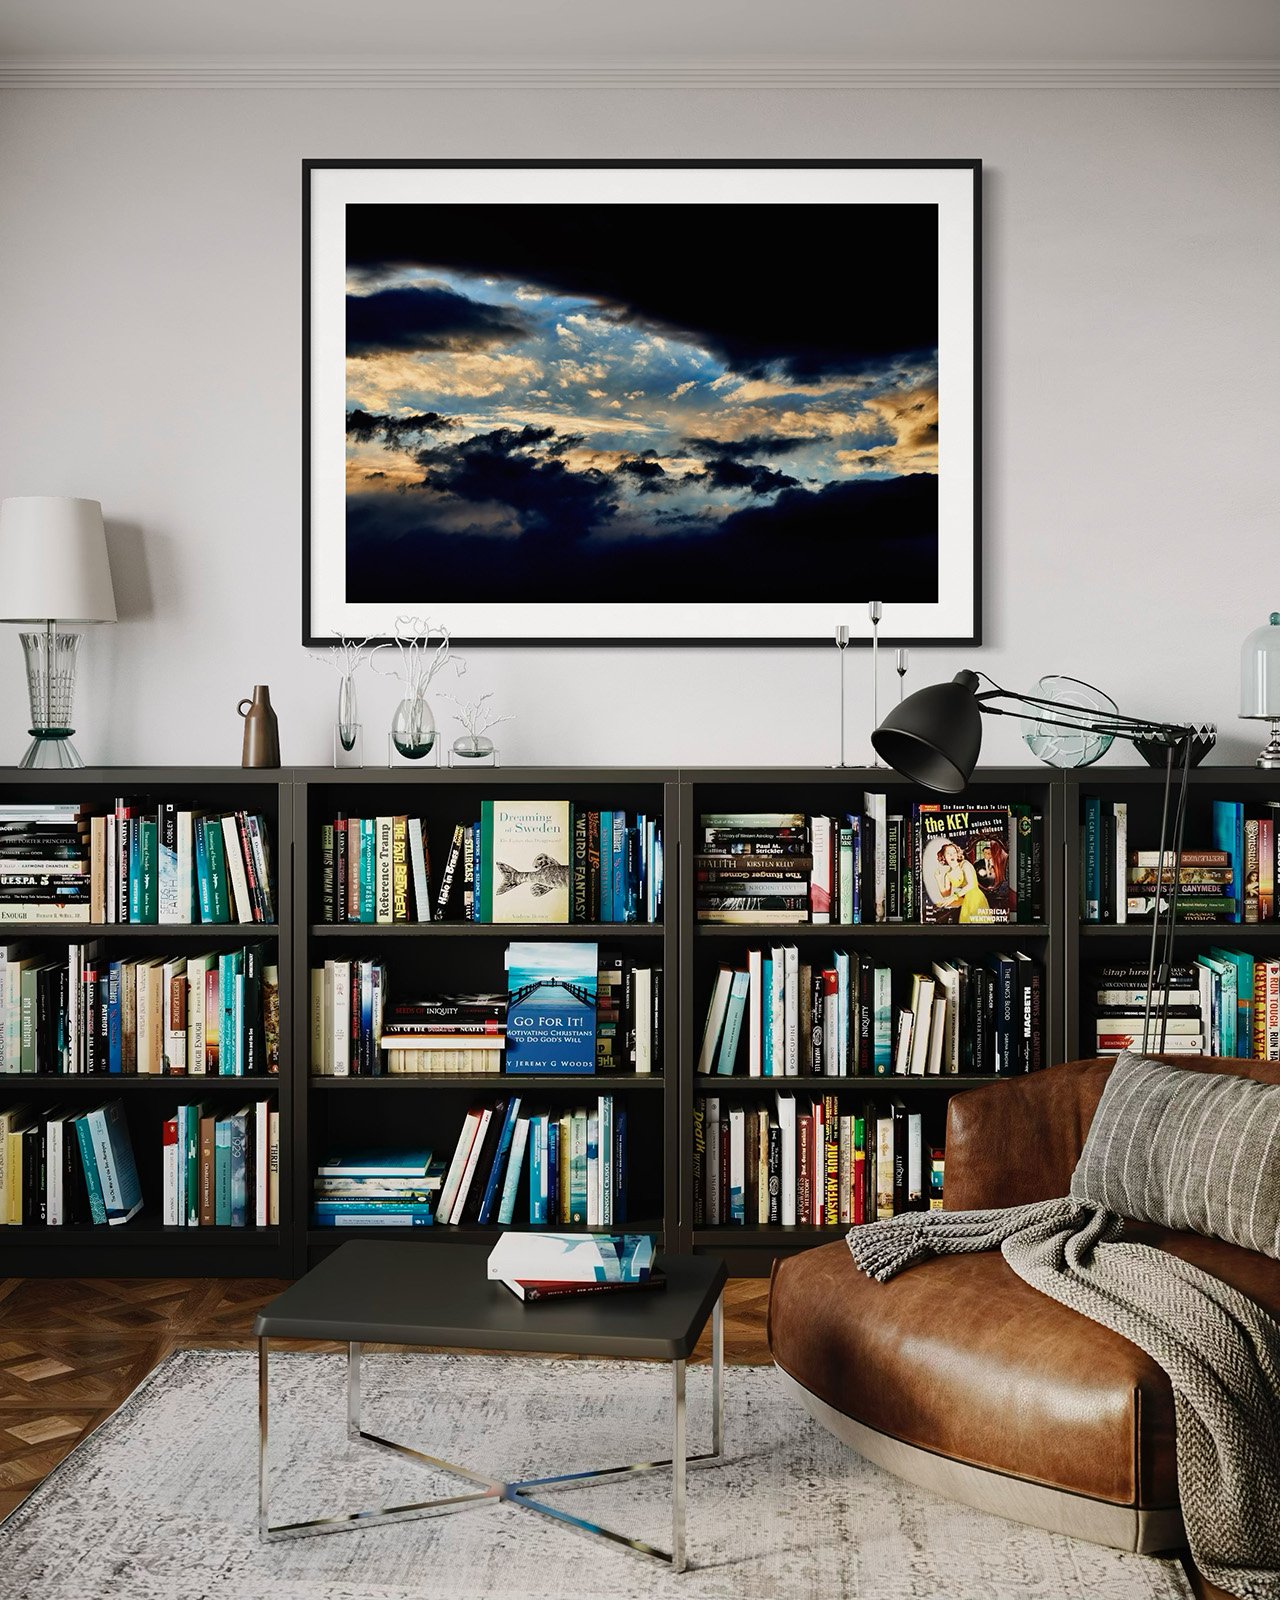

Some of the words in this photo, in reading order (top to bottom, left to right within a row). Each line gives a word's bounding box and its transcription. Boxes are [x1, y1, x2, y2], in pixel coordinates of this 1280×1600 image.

[500, 812, 552, 824] Dreaming
[515, 823, 561, 833] Sweden
[925, 817, 945, 833] the
[946, 812, 969, 831] KEY
[971, 820, 991, 828] unlocks
[166, 819, 174, 844] COBLEY
[380, 824, 390, 859] Tramp
[393, 821, 406, 840] THE
[575, 819, 587, 859] WEIRD
[889, 826, 897, 842] THE
[948, 830, 967, 838] murder
[982, 826, 1004, 834] violence
[323, 849, 333, 865] THIS
[445, 849, 459, 874] Brass
[464, 839, 474, 883] STAIRCASE
[889, 843, 897, 872] HOBBIT
[323, 867, 333, 893] WOMAN
[379, 862, 389, 916] Reference
[443, 874, 453, 883] in
[1181, 884, 1222, 893] GANYMEDE
[394, 864, 407, 918] BETWEEN
[437, 885, 450, 905] Halo
[575, 866, 587, 919] FANTASY
[2, 911, 27, 920] ENOUGH
[323, 905, 333, 922] MINE
[1033, 975, 1041, 989] THE
[1103, 968, 1127, 978] kitap
[1254, 962, 1267, 1004] HARD
[1270, 977, 1278, 995] RUN
[426, 1008, 459, 1016] INIQUITY
[1033, 990, 1041, 1016] SNOWS
[1269, 998, 1278, 1030] TOUGH,
[514, 1016, 534, 1027] GO
[539, 1017, 564, 1027] FOR
[567, 1017, 584, 1027] IT!
[861, 1005, 870, 1037] INIQUITY
[1254, 1007, 1266, 1023] IT
[193, 1022, 202, 1048] ENOUGH
[1270, 1032, 1278, 1048] RUN
[193, 1049, 202, 1072] ROUGH
[515, 1060, 547, 1068] JEREMY
[693, 1110, 706, 1153] Death
[232, 1136, 241, 1158] 1929
[270, 1144, 278, 1174] THRIFT
[826, 1144, 838, 1174] BOOK
[895, 1153, 904, 1186] INIQUITY
[826, 1178, 839, 1225] MYSTERY
